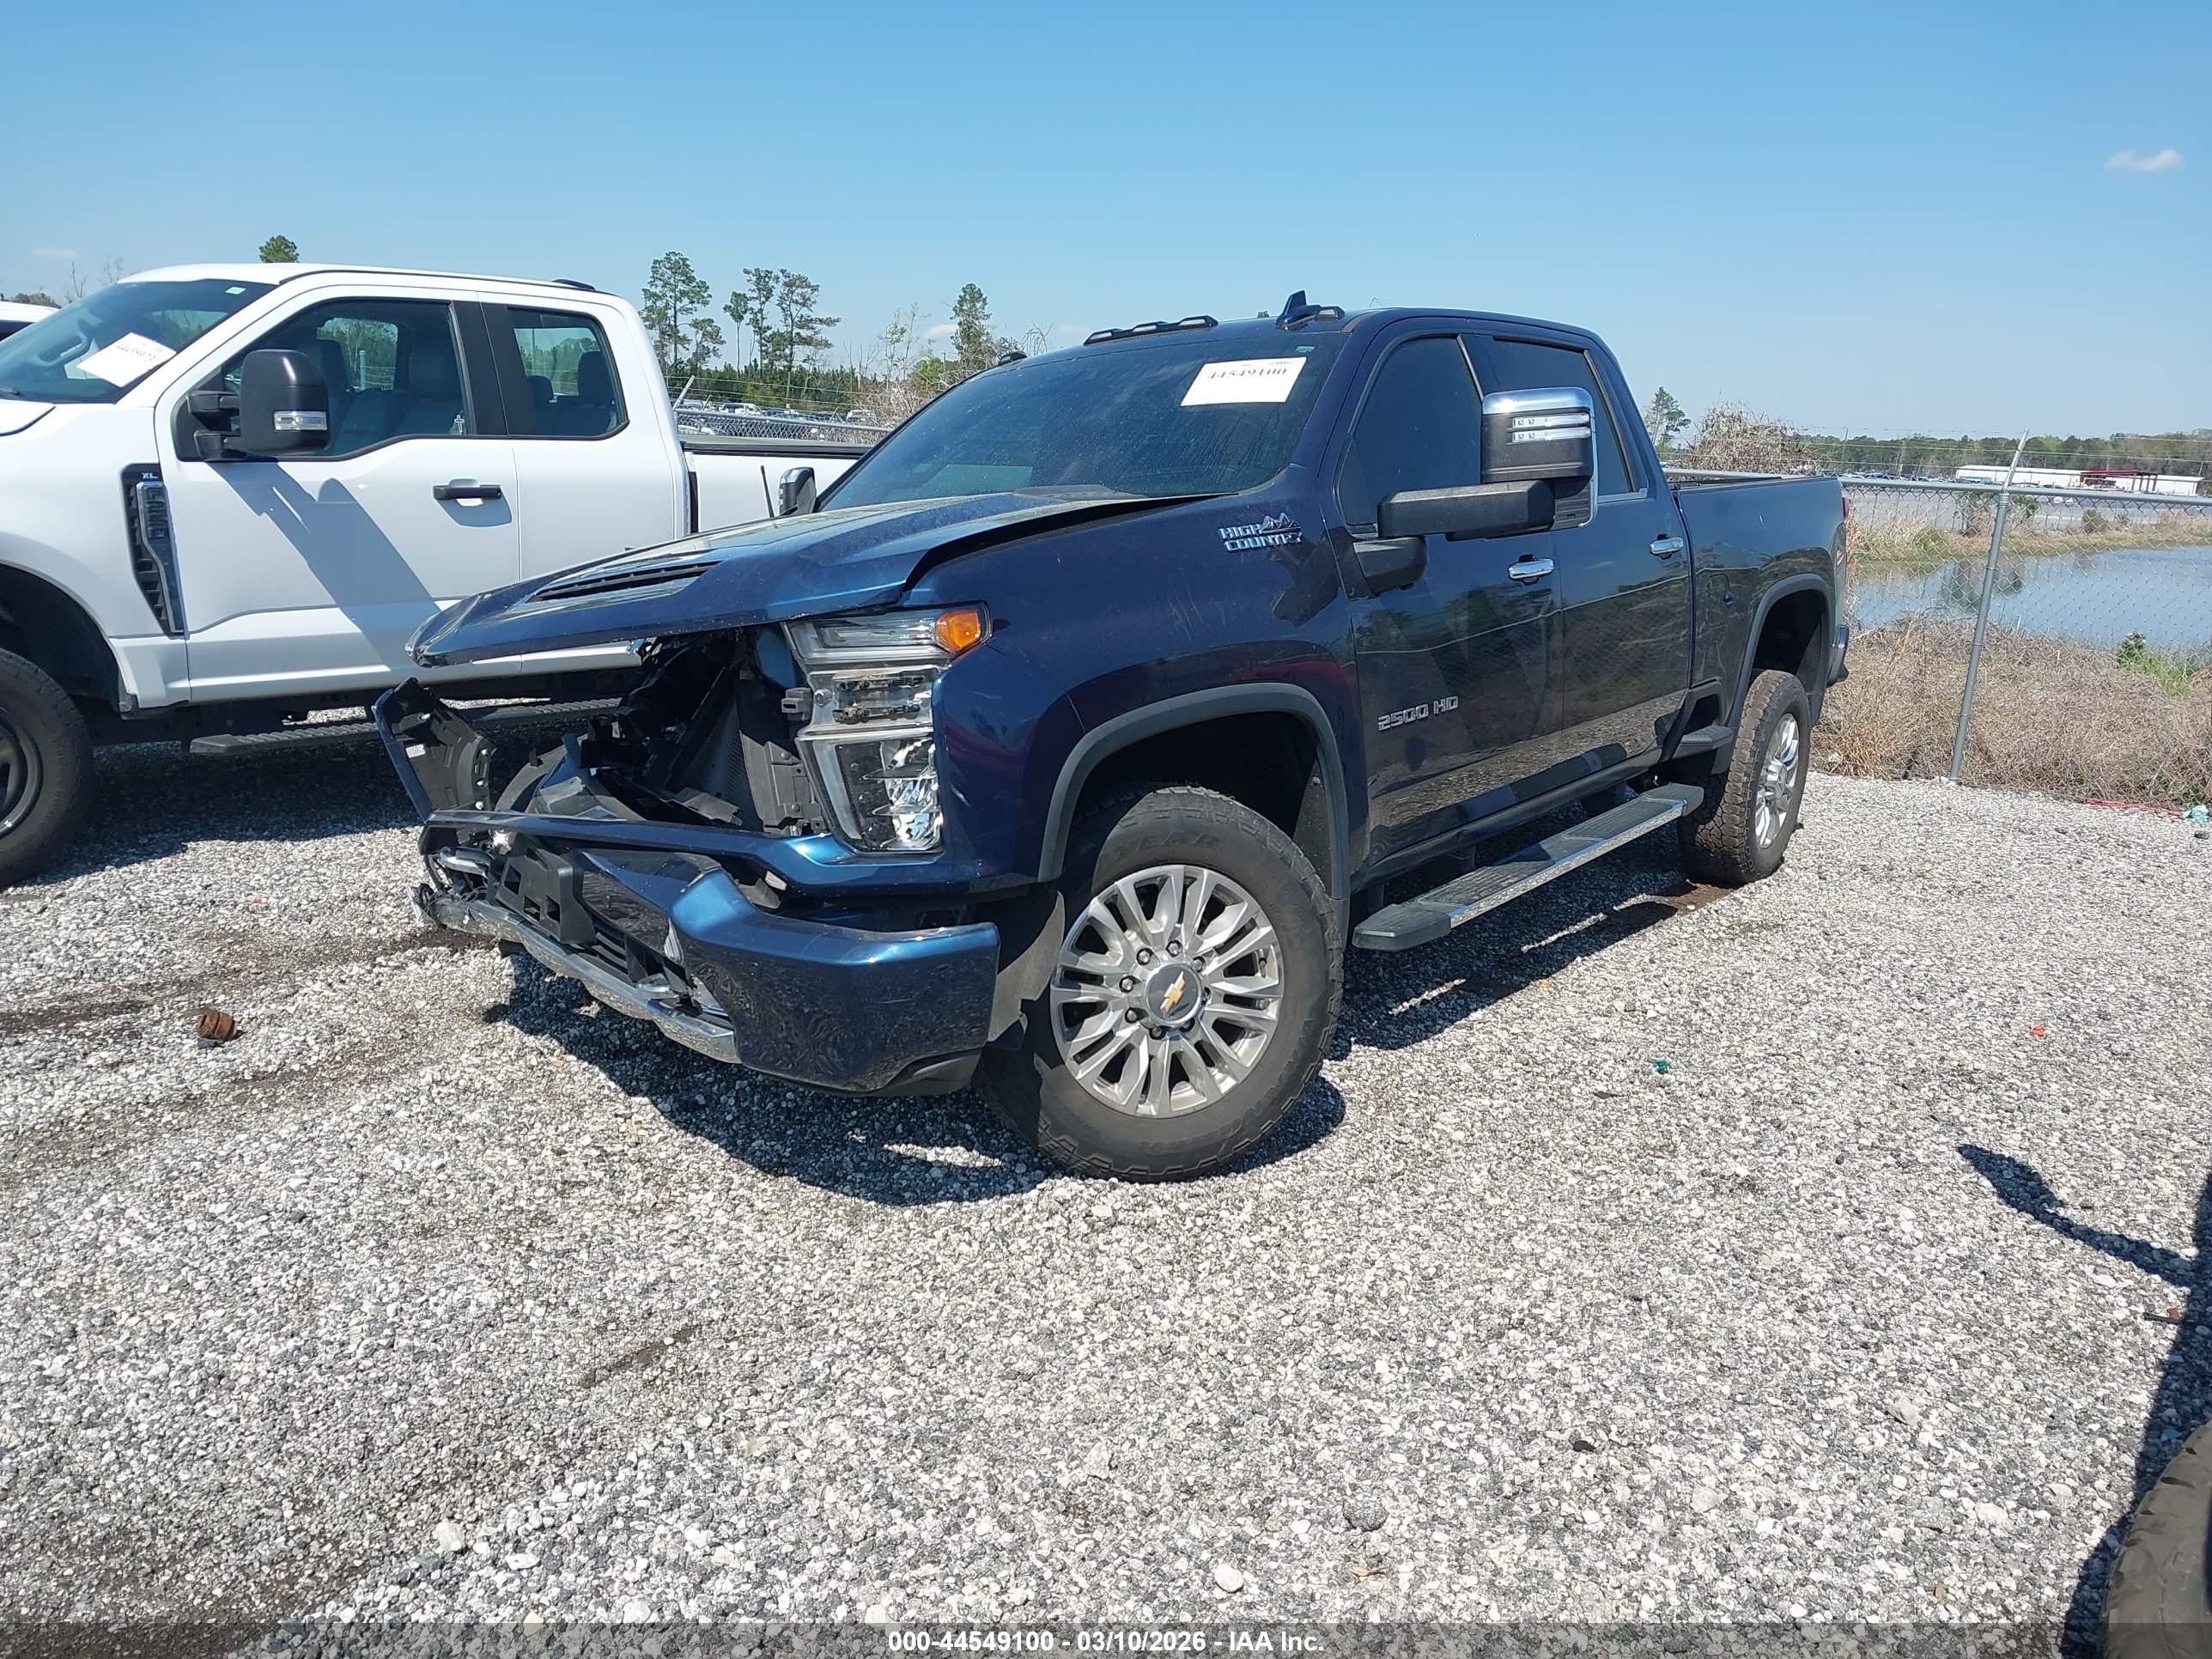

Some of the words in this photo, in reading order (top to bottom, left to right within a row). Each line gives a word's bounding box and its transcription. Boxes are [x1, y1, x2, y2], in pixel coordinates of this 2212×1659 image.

[1218, 523, 1262, 540] HIGH
[1224, 531, 1303, 552] COUNTRY
[1377, 703, 1429, 732] 2500
[1433, 696, 1459, 715] HD
